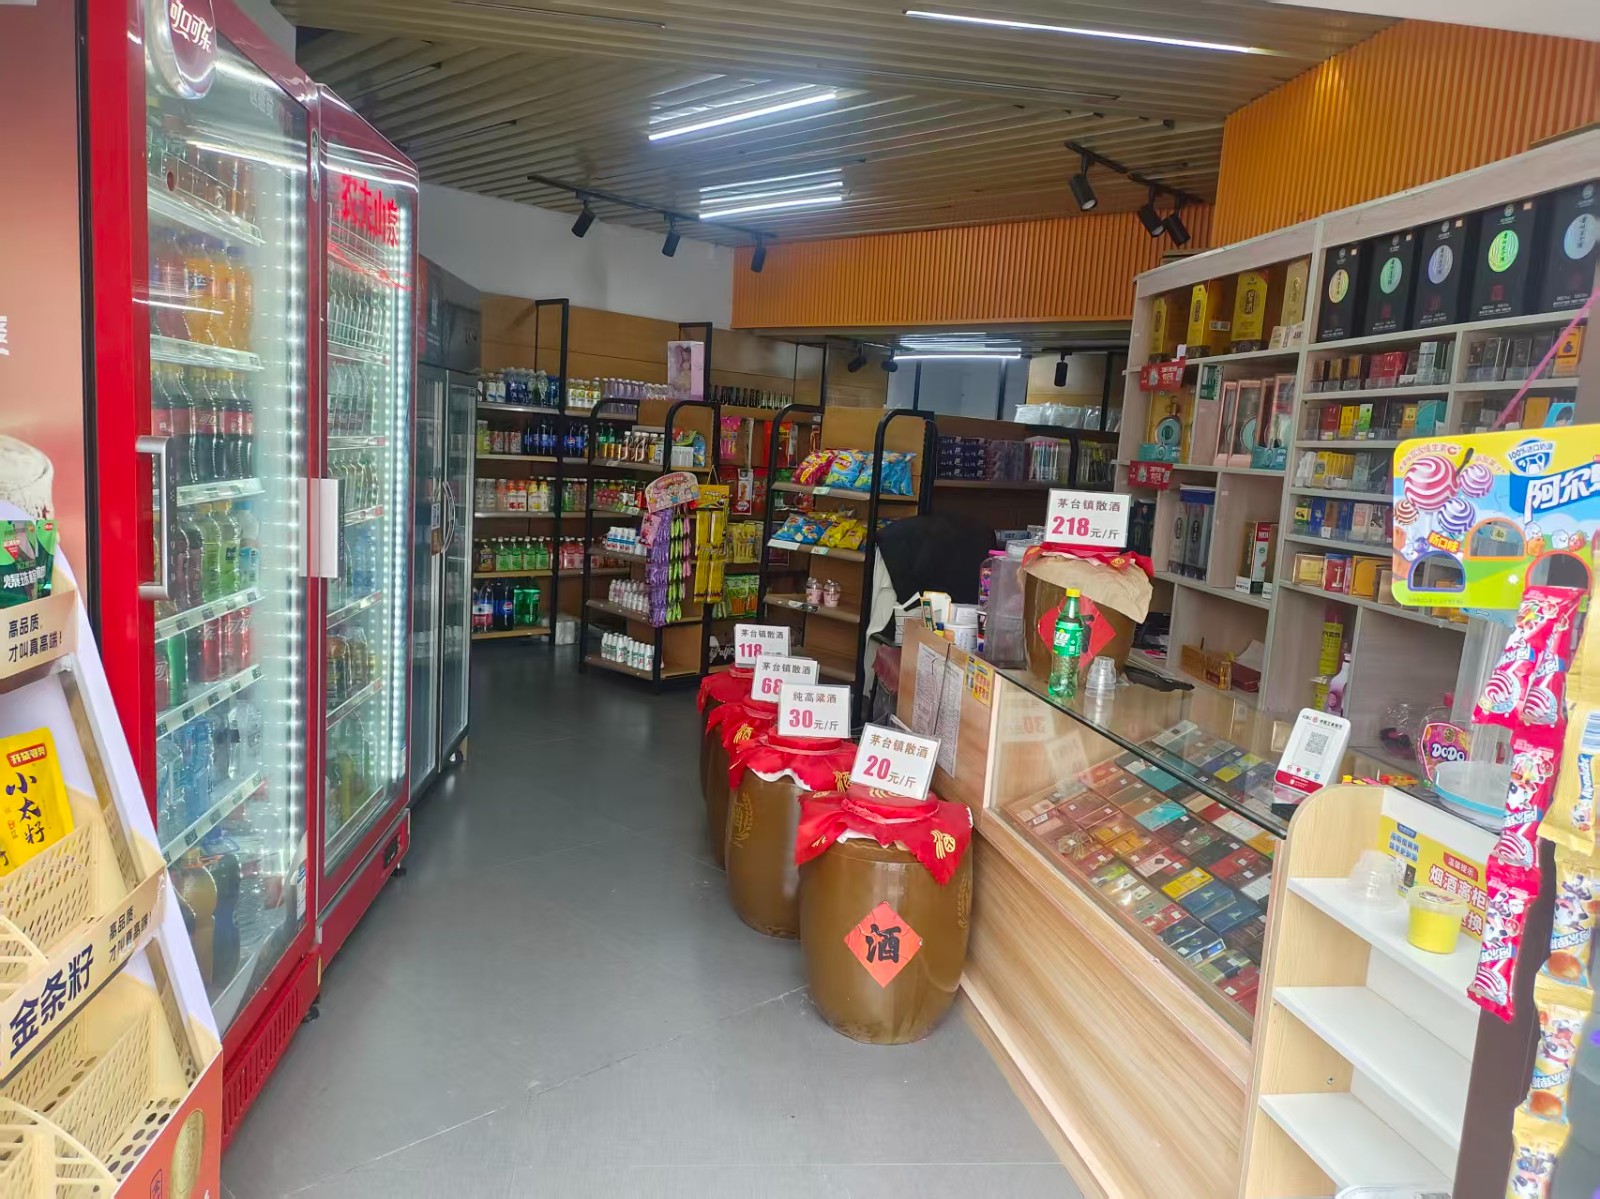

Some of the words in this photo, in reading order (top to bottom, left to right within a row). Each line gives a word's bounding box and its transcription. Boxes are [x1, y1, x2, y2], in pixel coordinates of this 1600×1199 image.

[170, 0, 213, 53] 可口可乐
[1057, 497, 1121, 513] 茅台镇散酒
[1428, 532, 1459, 553] 新口味
[740, 628, 785, 640] 茅台镇散酒
[762, 661, 812, 675] 茅台镇散酒
[792, 691, 838, 704] 纯高粱酒
[869, 733, 929, 760] 茅台镇散酒
[5, 772, 45, 844] 小太籽
[865, 923, 902, 964] 酒
[9, 943, 95, 1060] 金条籽
